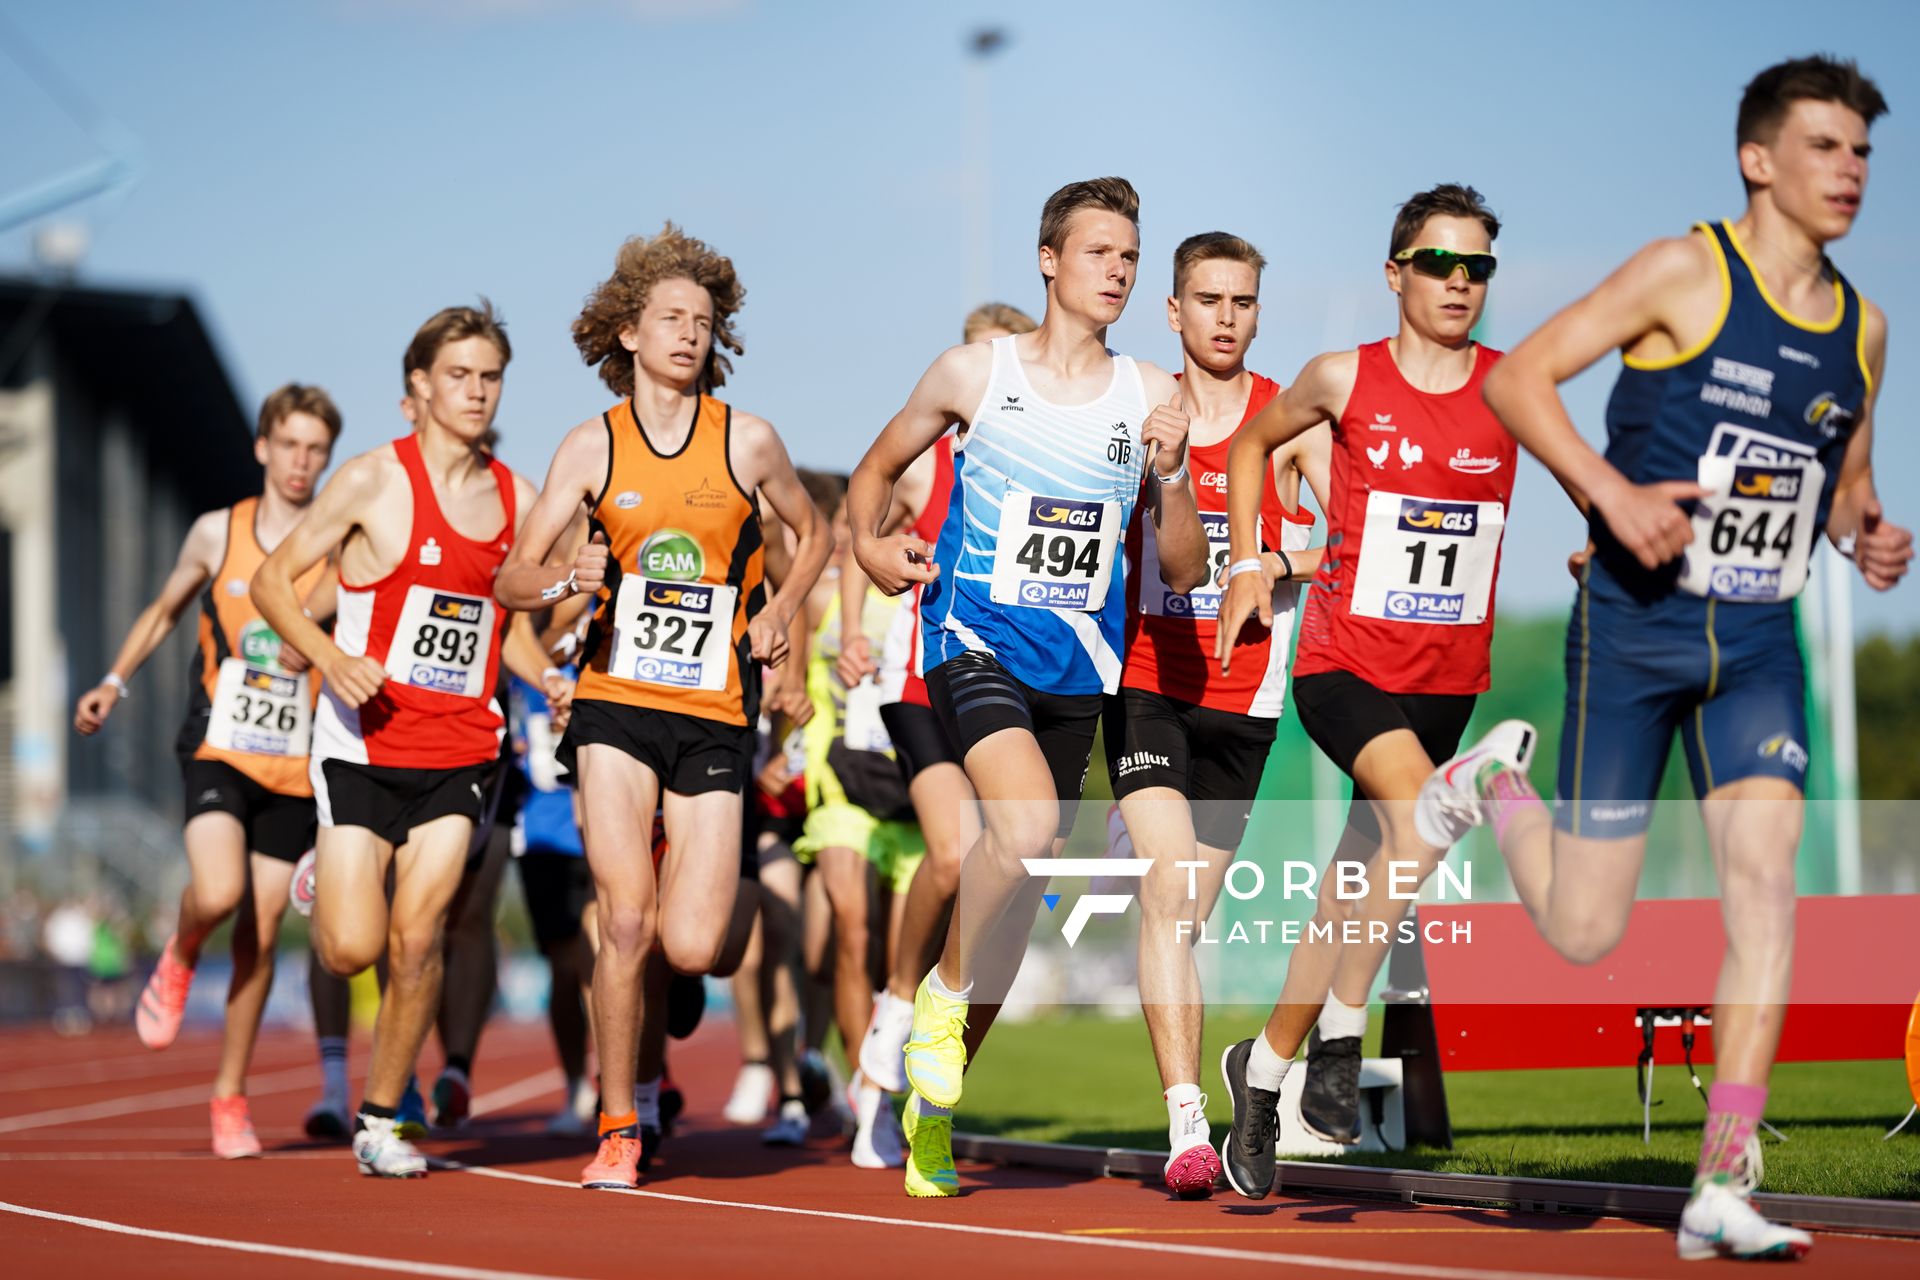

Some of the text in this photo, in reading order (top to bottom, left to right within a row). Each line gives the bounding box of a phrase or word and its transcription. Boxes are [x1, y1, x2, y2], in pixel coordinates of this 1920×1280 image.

[1001, 404, 1024, 412] erima
[1107, 438, 1131, 465] OTB
[1457, 448, 1471, 459] LG
[1770, 474, 1798, 498] GLS
[1068, 510, 1097, 526] GLS
[1441, 513, 1474, 531] GLS
[1203, 522, 1229, 538] GLS
[1711, 508, 1797, 560] 644
[647, 552, 696, 572] EAM
[1015, 533, 1101, 578] 494
[1405, 541, 1459, 587] 11
[680, 593, 709, 610] GLS
[1049, 586, 1087, 600] PLAN
[458, 602, 481, 622] GLS
[1191, 597, 1222, 610] PLA
[1417, 597, 1462, 612] PLAN
[634, 612, 713, 657] 327
[413, 624, 479, 667] 893
[435, 670, 468, 687] PLAN
[662, 665, 700, 679] PLAN
[232, 694, 298, 733] 326
